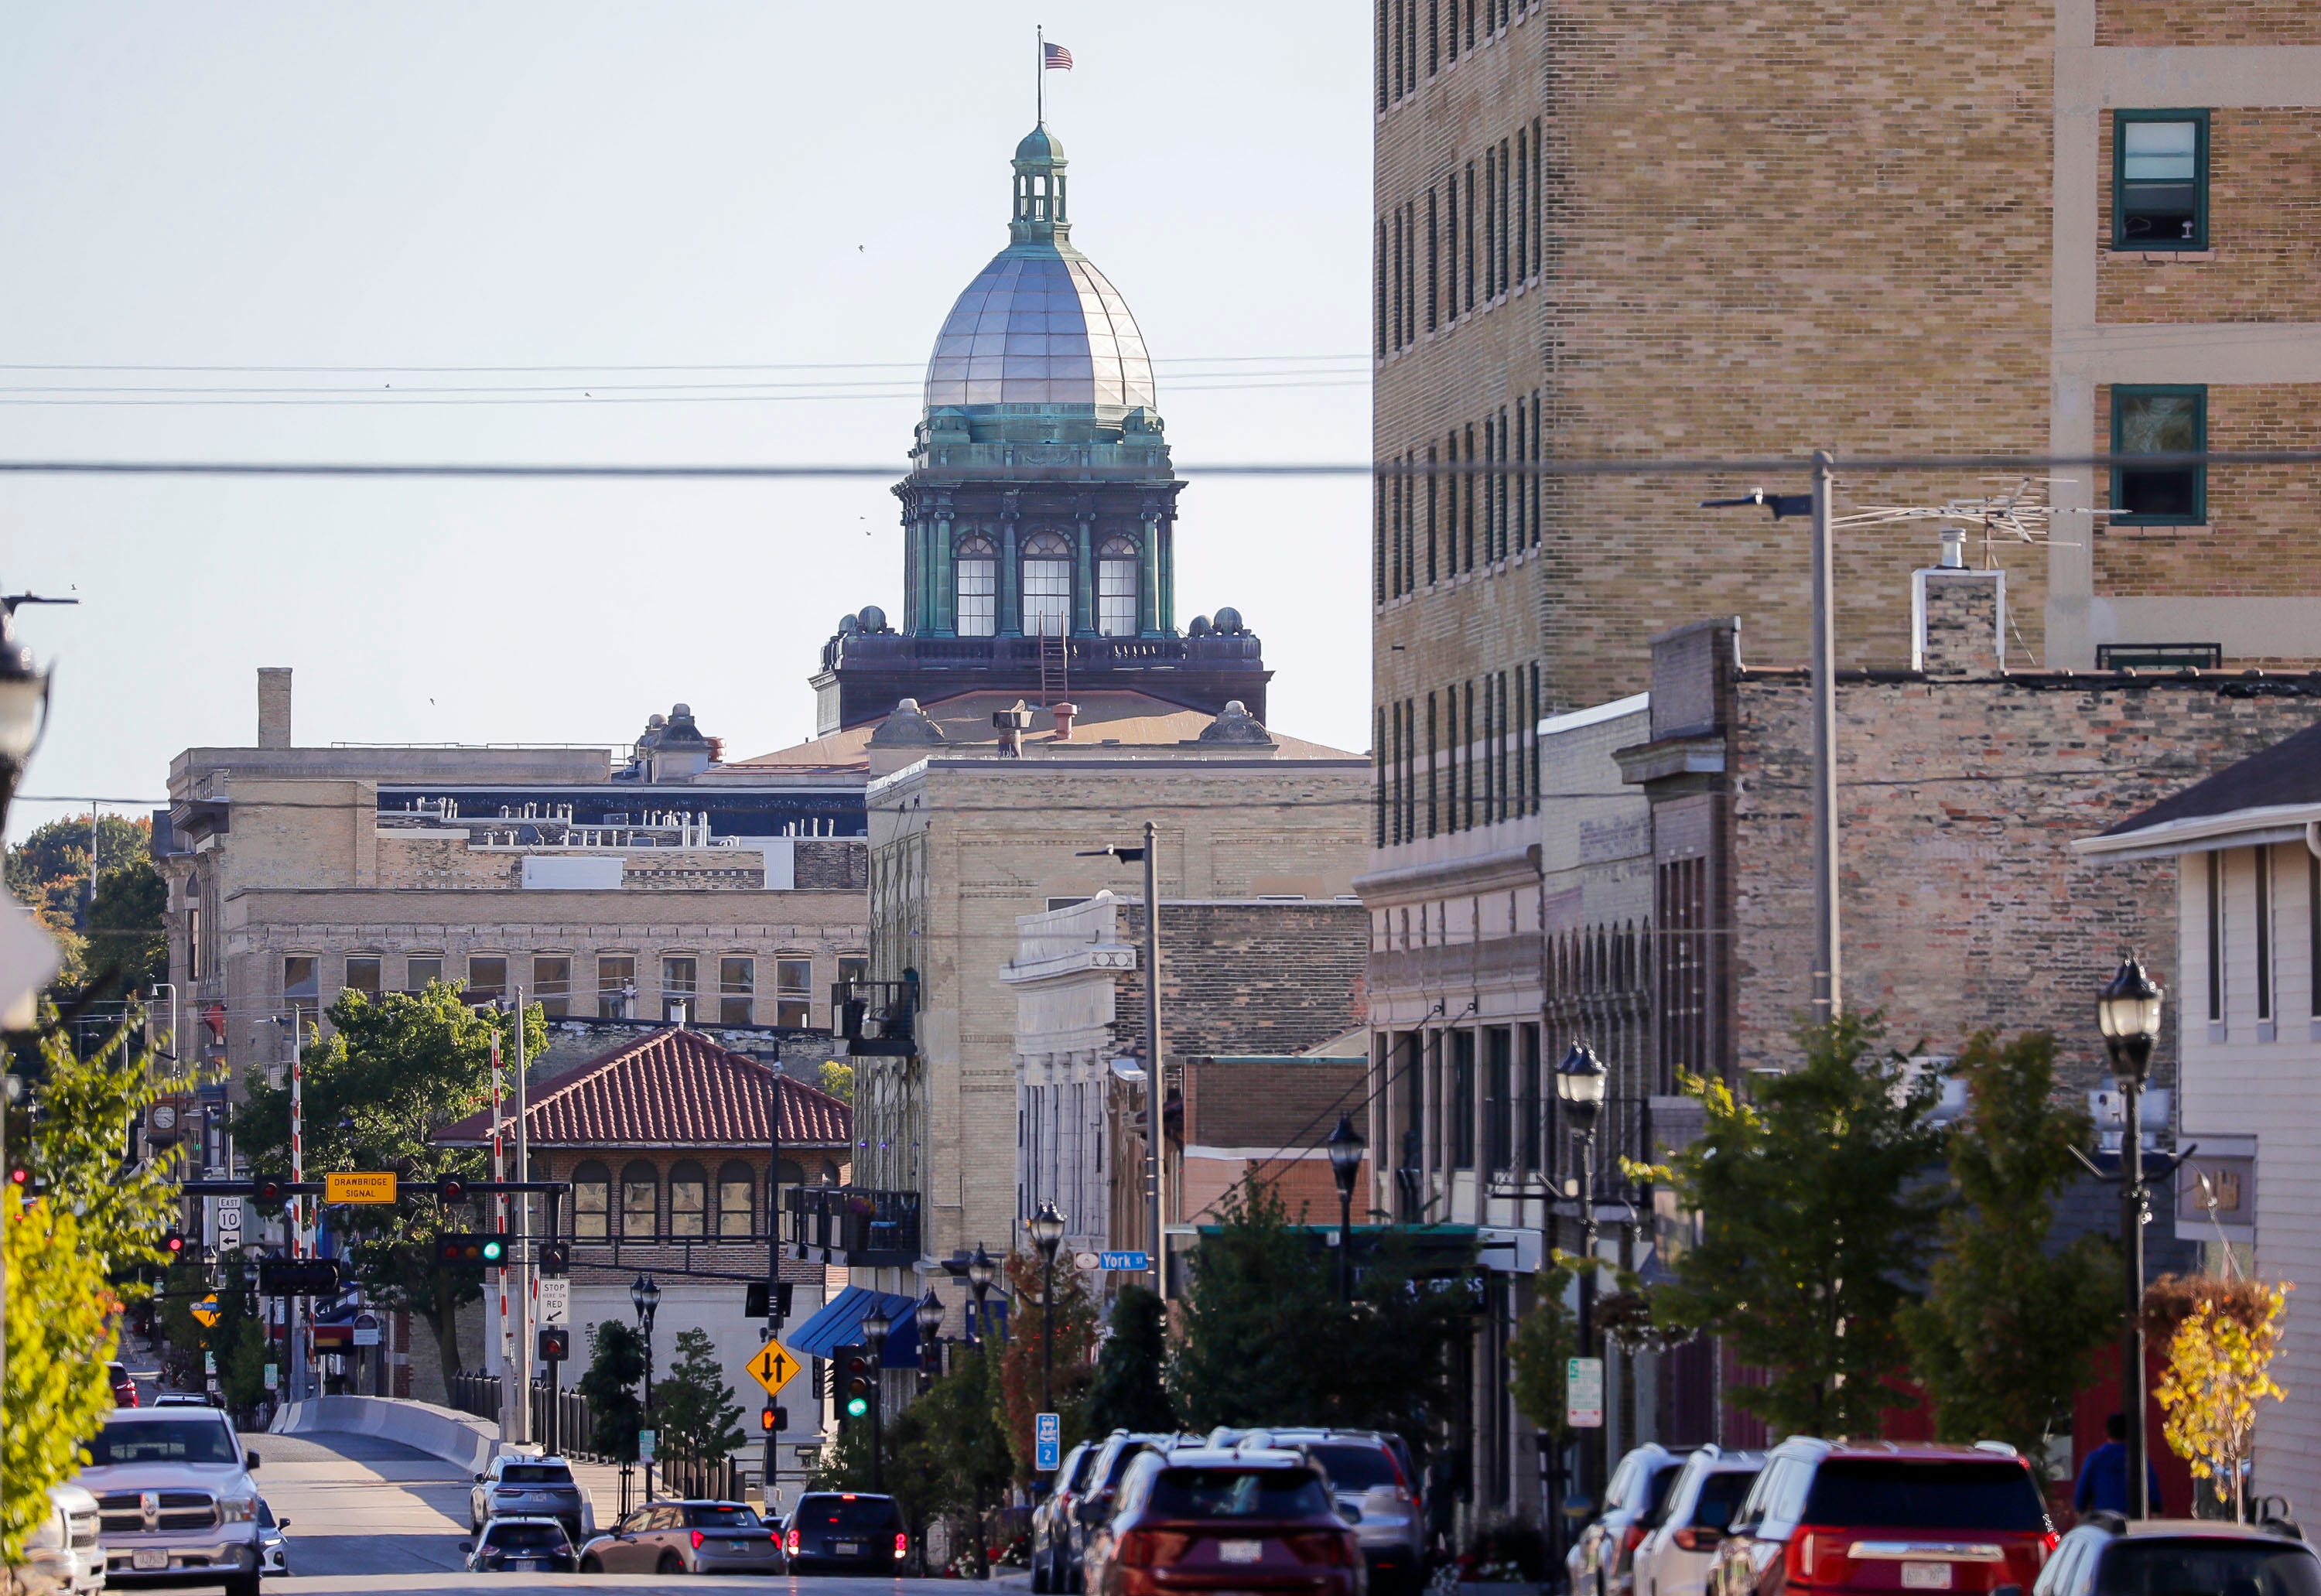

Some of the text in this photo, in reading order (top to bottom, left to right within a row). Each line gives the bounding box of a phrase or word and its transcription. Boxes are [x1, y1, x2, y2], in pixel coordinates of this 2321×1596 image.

[223, 1213, 237, 1226] 10
[1103, 1254, 1130, 1267] York
[1044, 1449, 1051, 1461] 2
